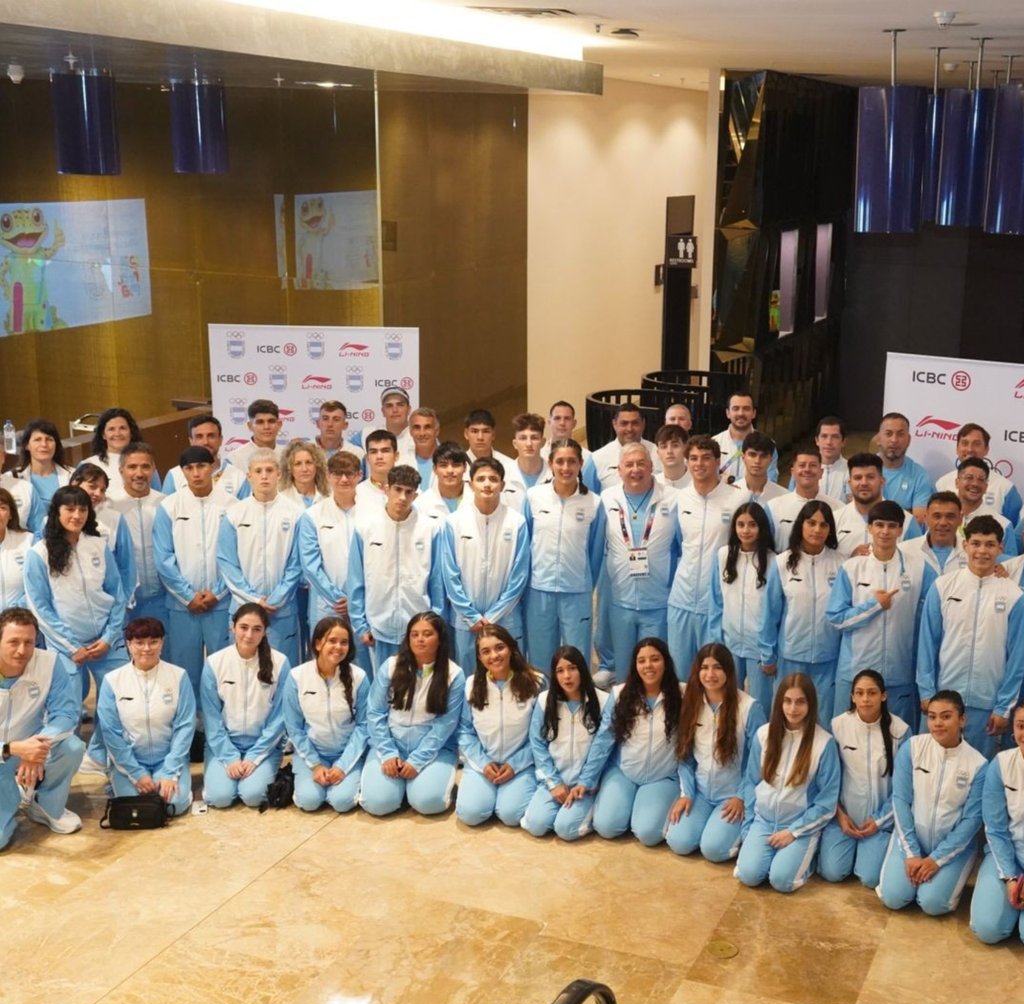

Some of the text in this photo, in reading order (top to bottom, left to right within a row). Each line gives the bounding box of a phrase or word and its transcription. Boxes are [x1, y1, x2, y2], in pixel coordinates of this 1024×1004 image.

[256, 345, 280, 354] ICBC
[217, 375, 240, 383] ICBC
[912, 370, 947, 386] ICBC
[375, 379, 398, 388] ICBC
